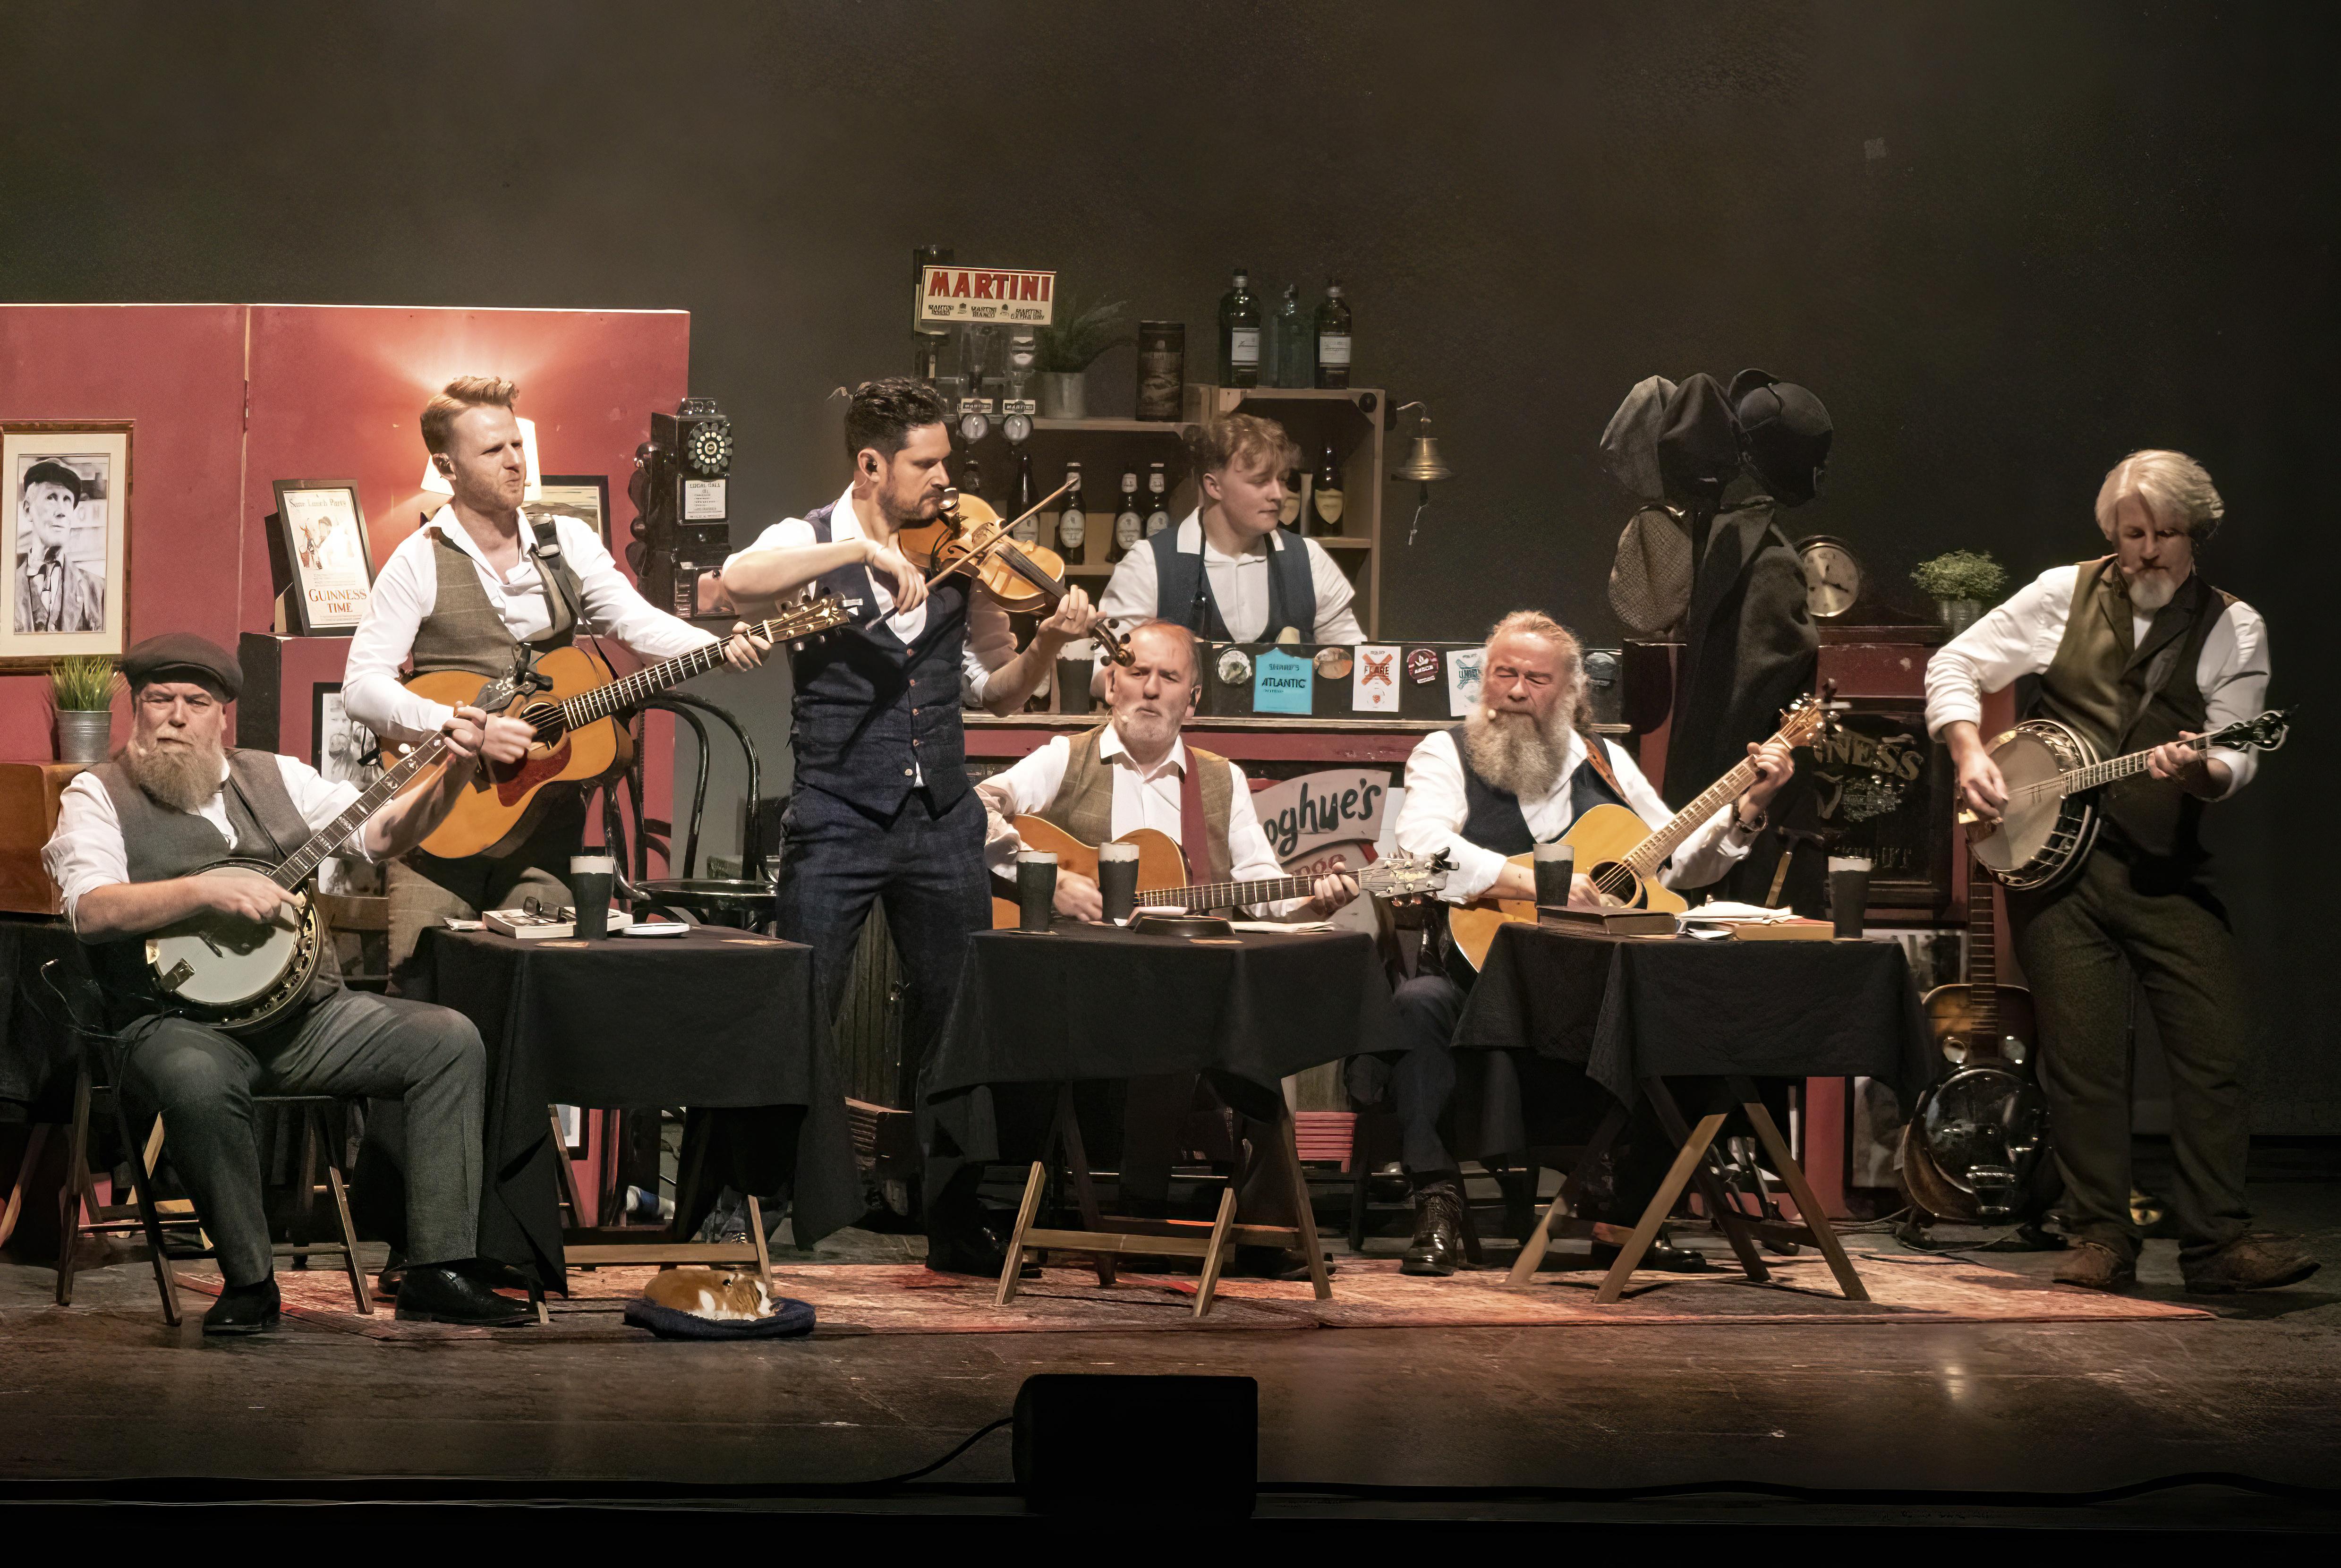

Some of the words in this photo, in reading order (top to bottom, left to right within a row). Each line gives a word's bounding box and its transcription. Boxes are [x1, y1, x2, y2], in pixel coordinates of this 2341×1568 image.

[928, 271, 1050, 302] MARTINI
[309, 589, 367, 602] GUINNESS
[327, 602, 353, 613] TIME
[1261, 677, 1307, 688] ATLANTIC
[1263, 778, 1381, 857] oghue's
